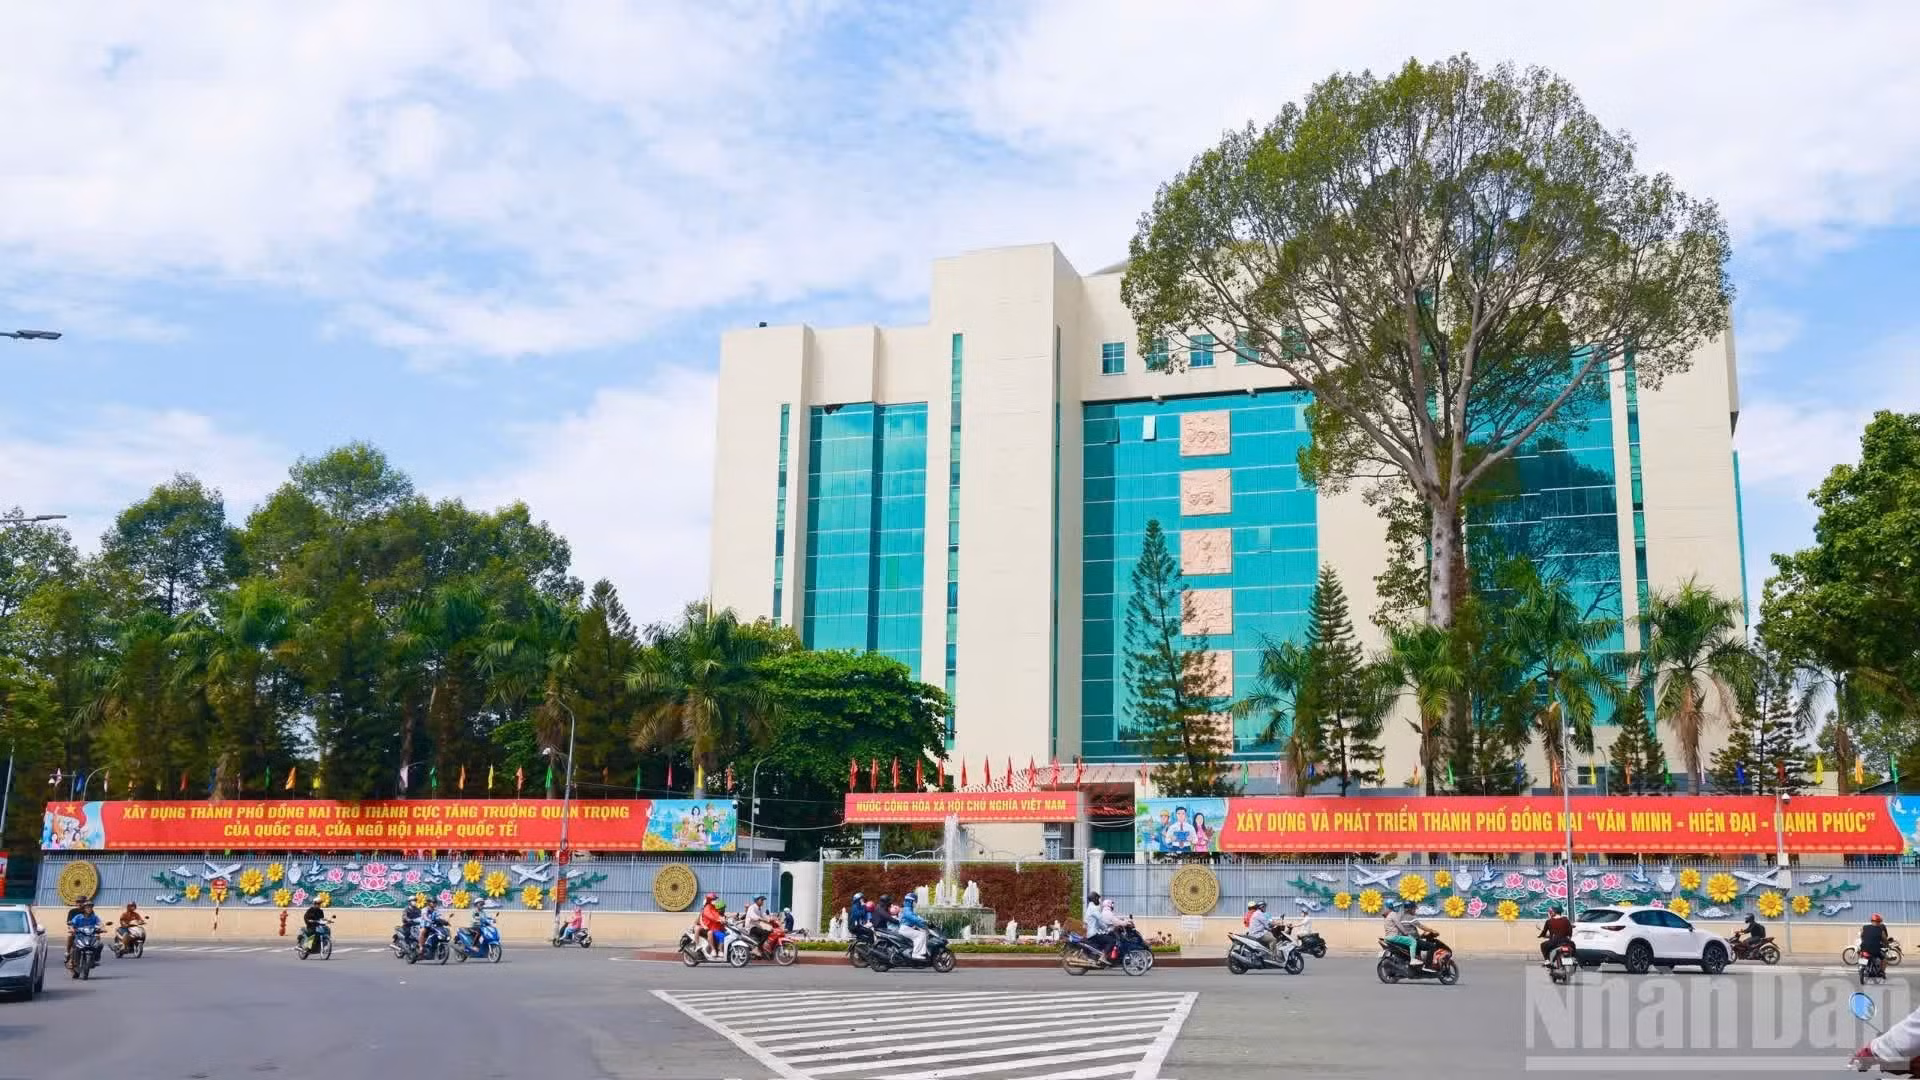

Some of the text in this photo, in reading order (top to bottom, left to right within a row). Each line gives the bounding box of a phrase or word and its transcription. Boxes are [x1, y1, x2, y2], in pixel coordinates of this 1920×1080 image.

[123, 804, 147, 819] XÂY
[308, 806, 331, 819] NAI
[1045, 799, 1066, 811] NAM
[1236, 808, 1263, 832] XÂY
[1267, 810, 1306, 837] DỰNG
[1311, 808, 1330, 832] VÀ
[1334, 807, 1372, 832] PHÁT
[1375, 804, 1418, 832] TRIỂN
[1422, 808, 1471, 832] THÀNH
[1476, 805, 1507, 832] PHỐ
[1511, 805, 1553, 832] ĐỒNG
[1557, 812, 1583, 832] NAI
[1631, 812, 1672, 832] MINH
[1688, 808, 1725, 837] HIỆN
[1729, 812, 1757, 837] ĐẠI
